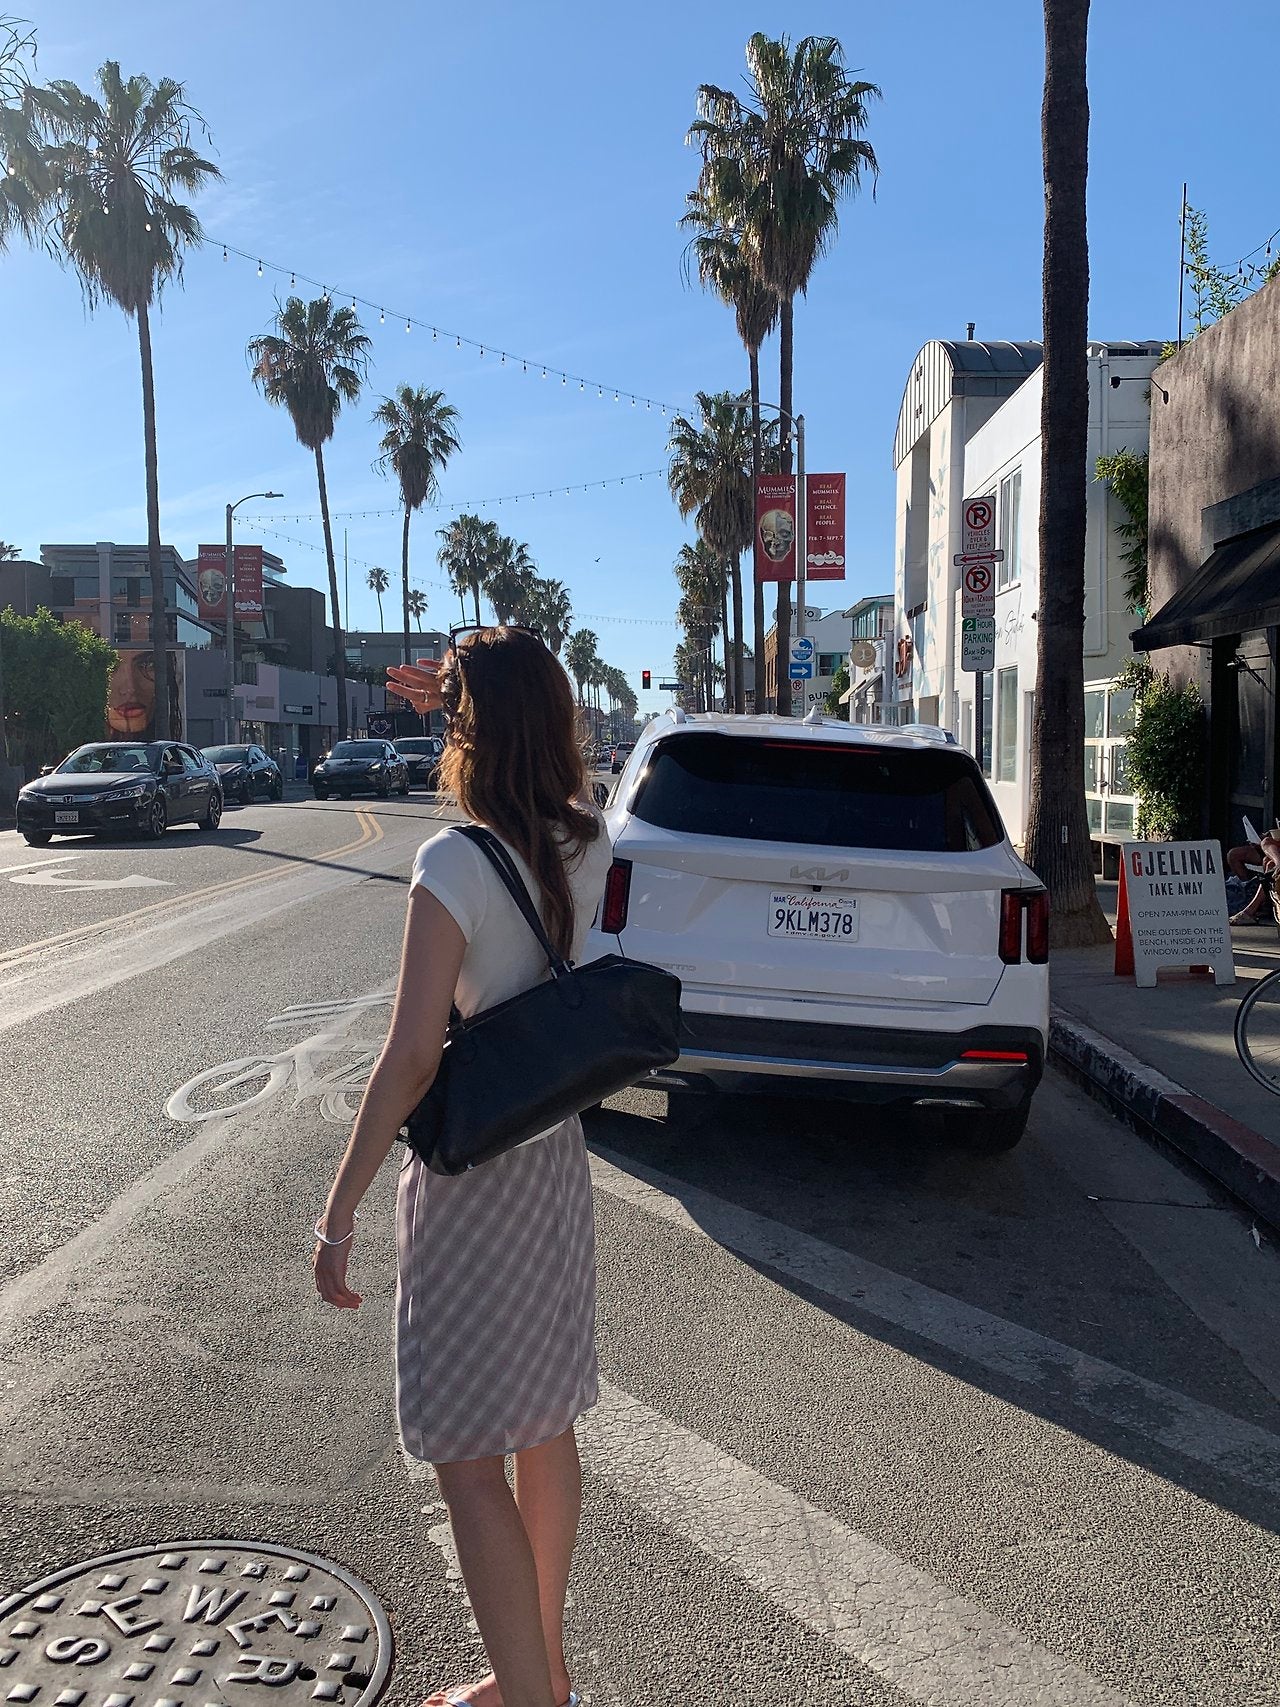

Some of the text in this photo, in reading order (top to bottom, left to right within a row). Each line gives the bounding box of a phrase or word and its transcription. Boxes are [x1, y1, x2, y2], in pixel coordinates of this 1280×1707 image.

[758, 485, 795, 495] MUMMIES
[965, 619, 993, 631] 2 HOUR
[964, 633, 993, 644] PARKING
[963, 646, 976, 656] 8AM
[980, 646, 992, 655] 8PM
[1131, 849, 1216, 877] GJELINA
[1149, 881, 1203, 896] TAKE AWAY
[787, 894, 842, 910] California
[1138, 909, 1220, 918] OPEN 7AM-9PM DAILY
[774, 908, 853, 935] 9KLM378
[1158, 928, 1192, 936] OUTSIDE
[1193, 927, 1207, 935] ON
[1209, 927, 1224, 935] THE
[1170, 937, 1197, 945] INSIDE
[1209, 936, 1224, 944] THE
[1182, 947, 1194, 955] OR
[1196, 946, 1207, 955] TO
[1208, 946, 1222, 954] GO
[45, 1584, 301, 1685] SEWER
